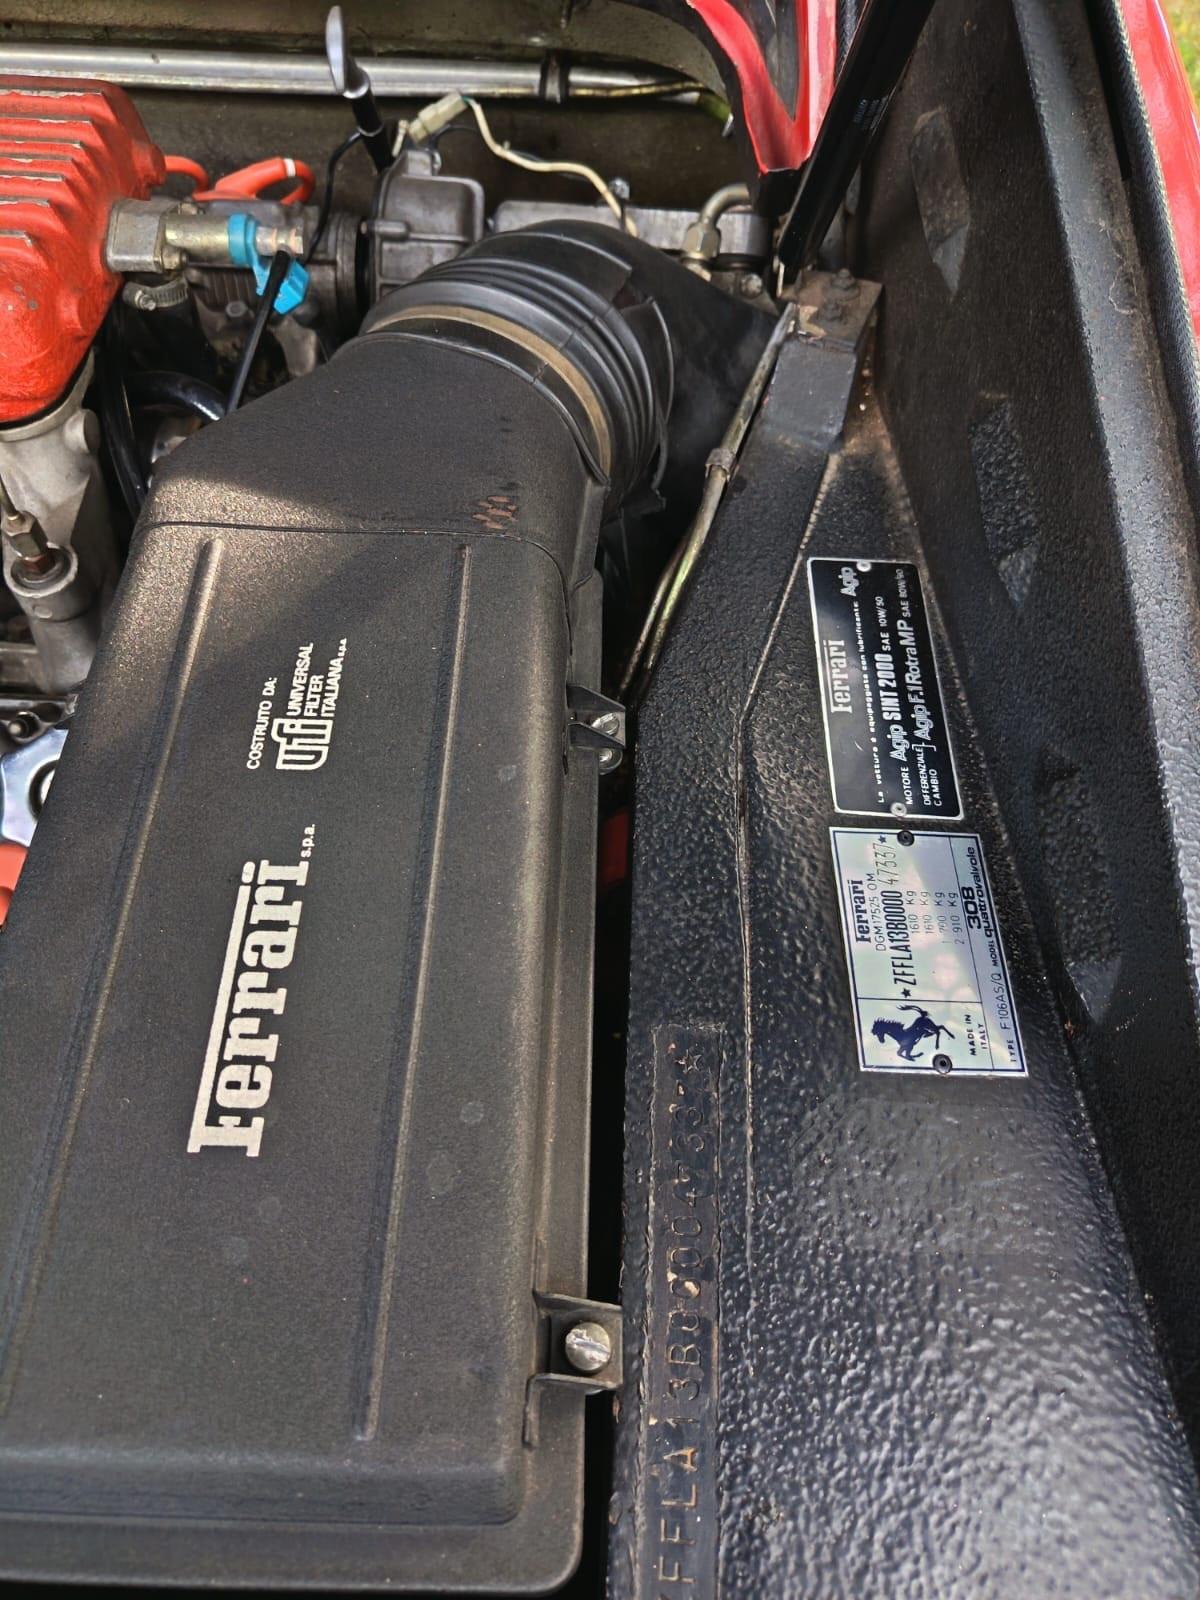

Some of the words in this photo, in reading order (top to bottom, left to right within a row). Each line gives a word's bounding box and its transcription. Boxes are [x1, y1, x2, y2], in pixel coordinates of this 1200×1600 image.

[839, 567, 859, 596] Agip
[875, 596, 888, 627] 10W/50
[900, 601, 911, 617] SAE
[880, 632, 891, 651] SAE
[286, 643, 313, 716] UNIVERSAL
[321, 658, 344, 717] ITALIANA
[823, 640, 852, 714] Ferrari
[875, 653, 897, 688] 2000
[304, 675, 324, 717] FILTER
[880, 690, 901, 720] SINT
[247, 701, 272, 769] COSTRUITO
[263, 677, 277, 695] DA:
[911, 705, 933, 740] Agip
[887, 724, 909, 761] Agip
[901, 767, 913, 805] MOTORE
[915, 748, 931, 805] DIFFERENZIALE
[929, 769, 942, 806] CAMBIO
[906, 891, 917, 904] Kg
[920, 892, 932, 905] Kg
[935, 893, 946, 906] Kg
[948, 893, 959, 907] Kg
[961, 887, 981, 929] 308
[967, 847, 993, 937] quattrovalvole
[847, 879, 871, 943] Ferrari
[988, 940, 998, 966] MODEL
[187, 860, 309, 1157] Ferrari
[300, 824, 316, 857] s.p.a.
[964, 1015, 972, 1024] IN
[978, 1023, 988, 1049] ITALY
[967, 1029, 976, 1055] MADE
[1007, 1040, 1017, 1062] TYPE
